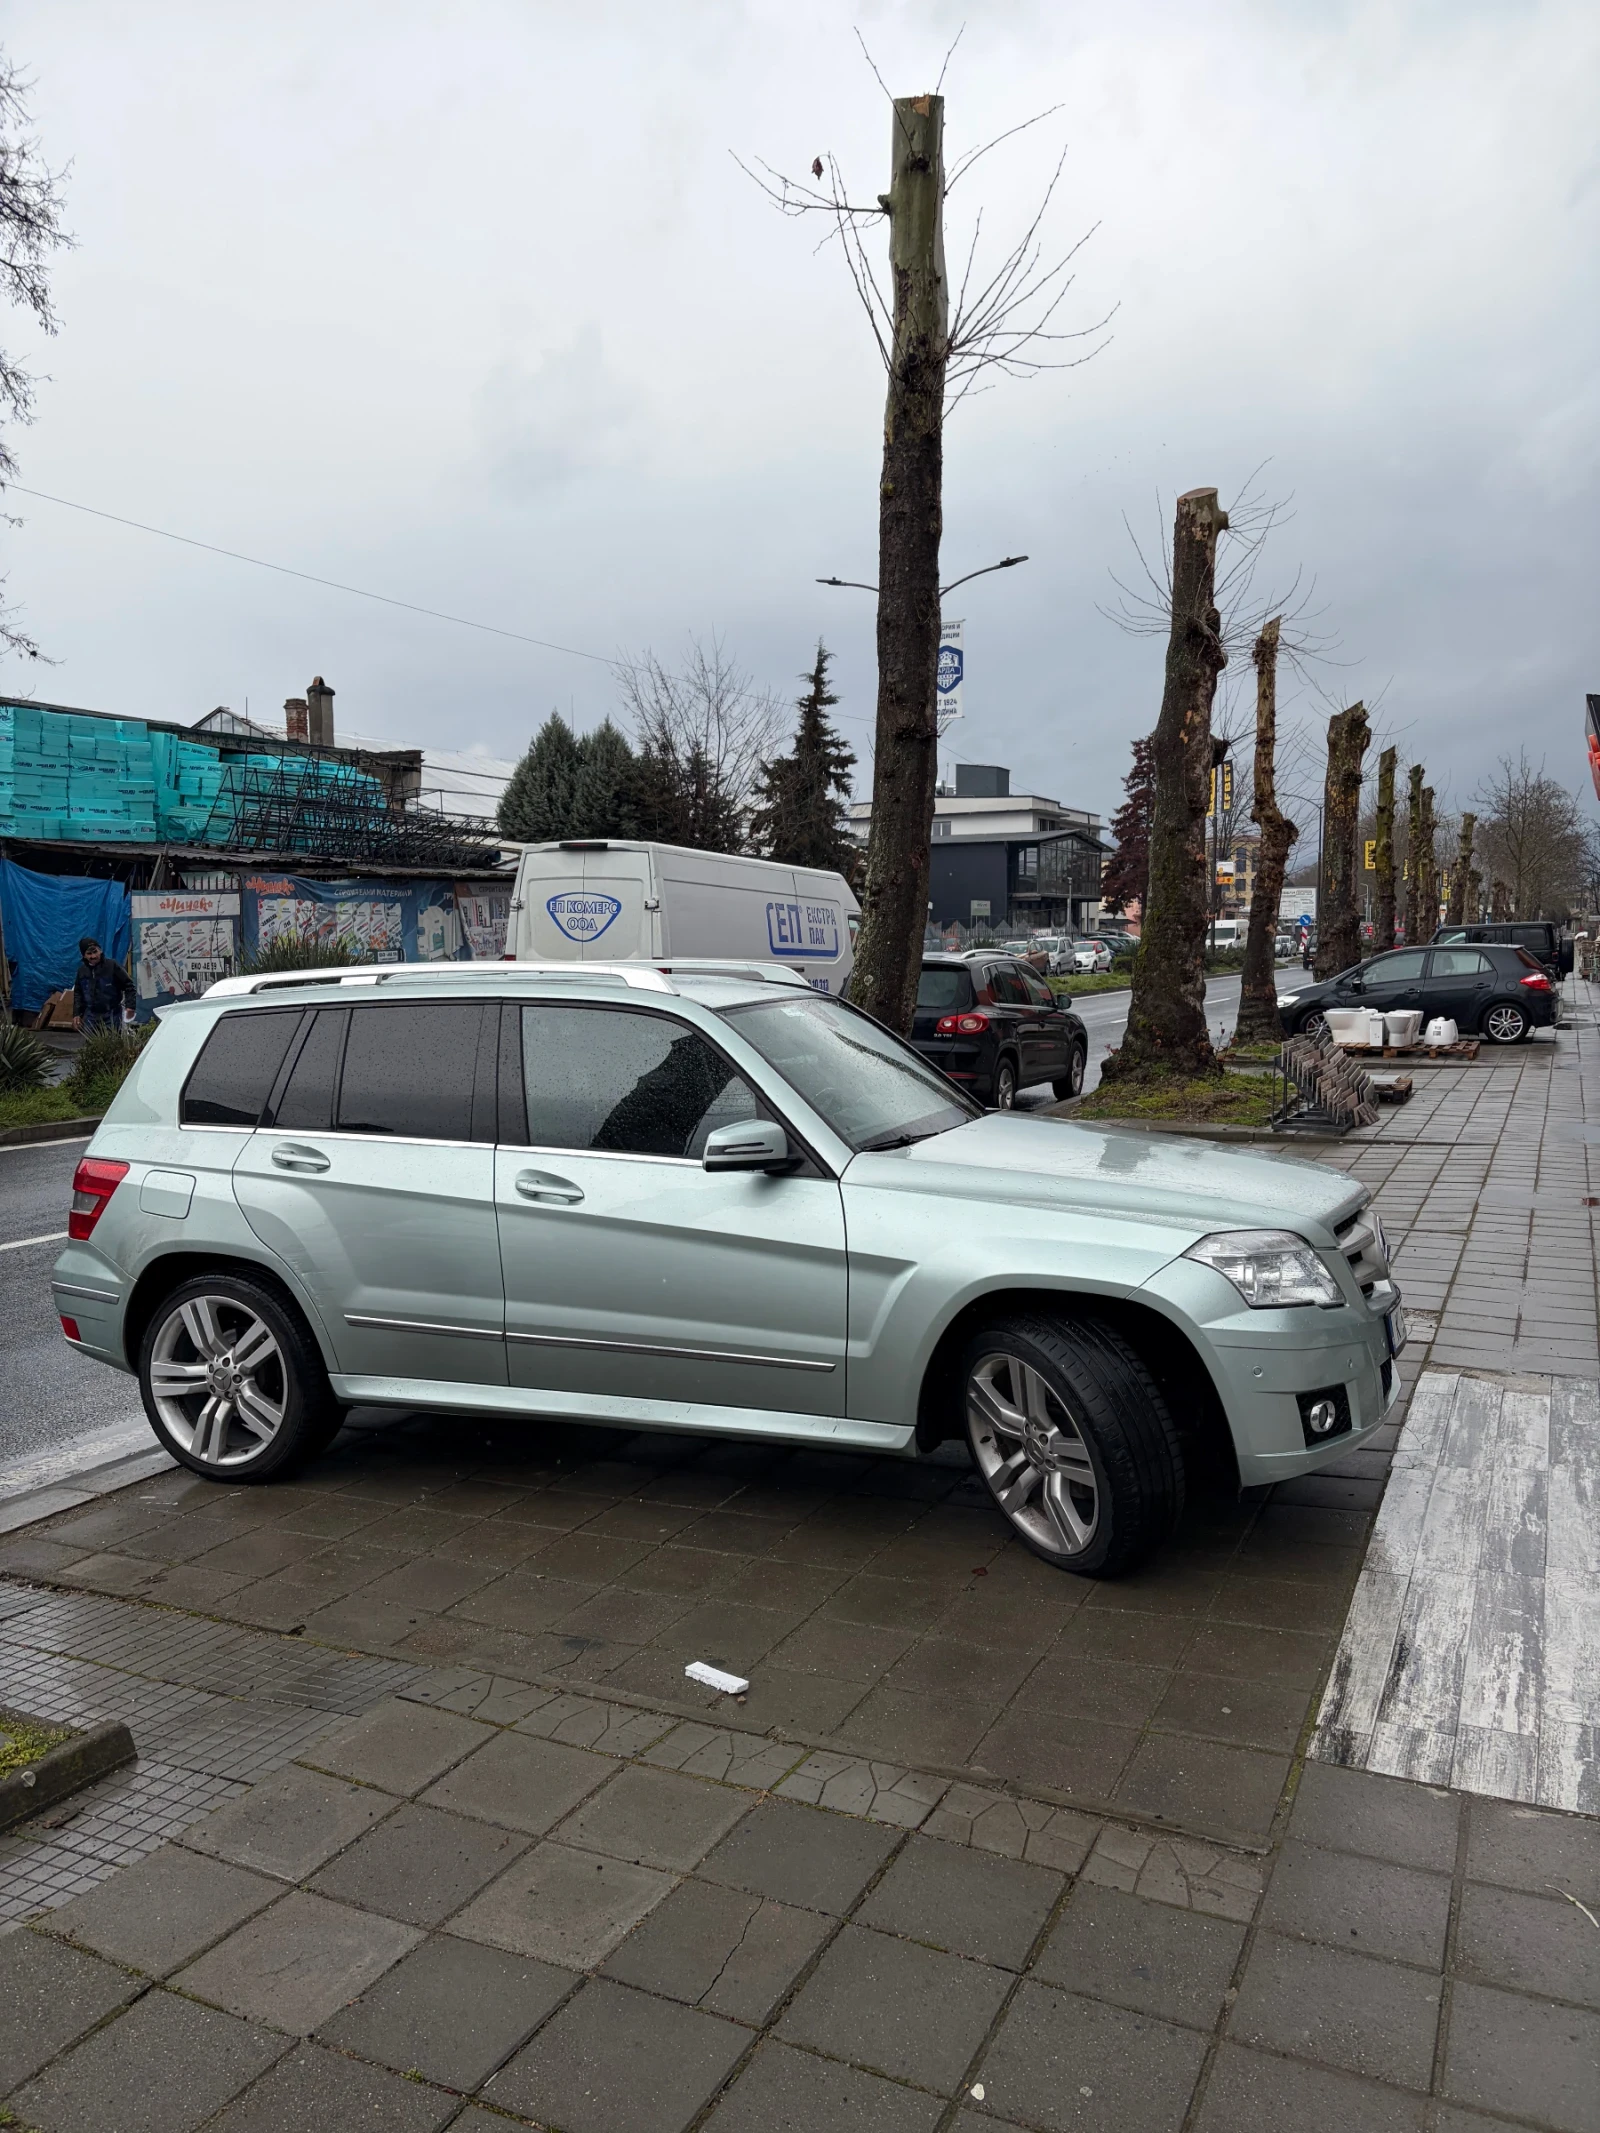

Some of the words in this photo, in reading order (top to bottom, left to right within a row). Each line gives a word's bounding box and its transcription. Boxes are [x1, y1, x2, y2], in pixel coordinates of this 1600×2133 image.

[941, 632, 960, 640] ДИЦИИ
[944, 698, 958, 706] 1924
[937, 707, 958, 716] ОДИНА
[1223, 763, 1231, 810] EFBET
[549, 900, 565, 913] ЕП
[567, 900, 618, 915] КОМЕРС
[567, 916, 598, 931] ООД
[806, 906, 837, 926] ЕКСТРА
[809, 927, 826, 945] ПАК
